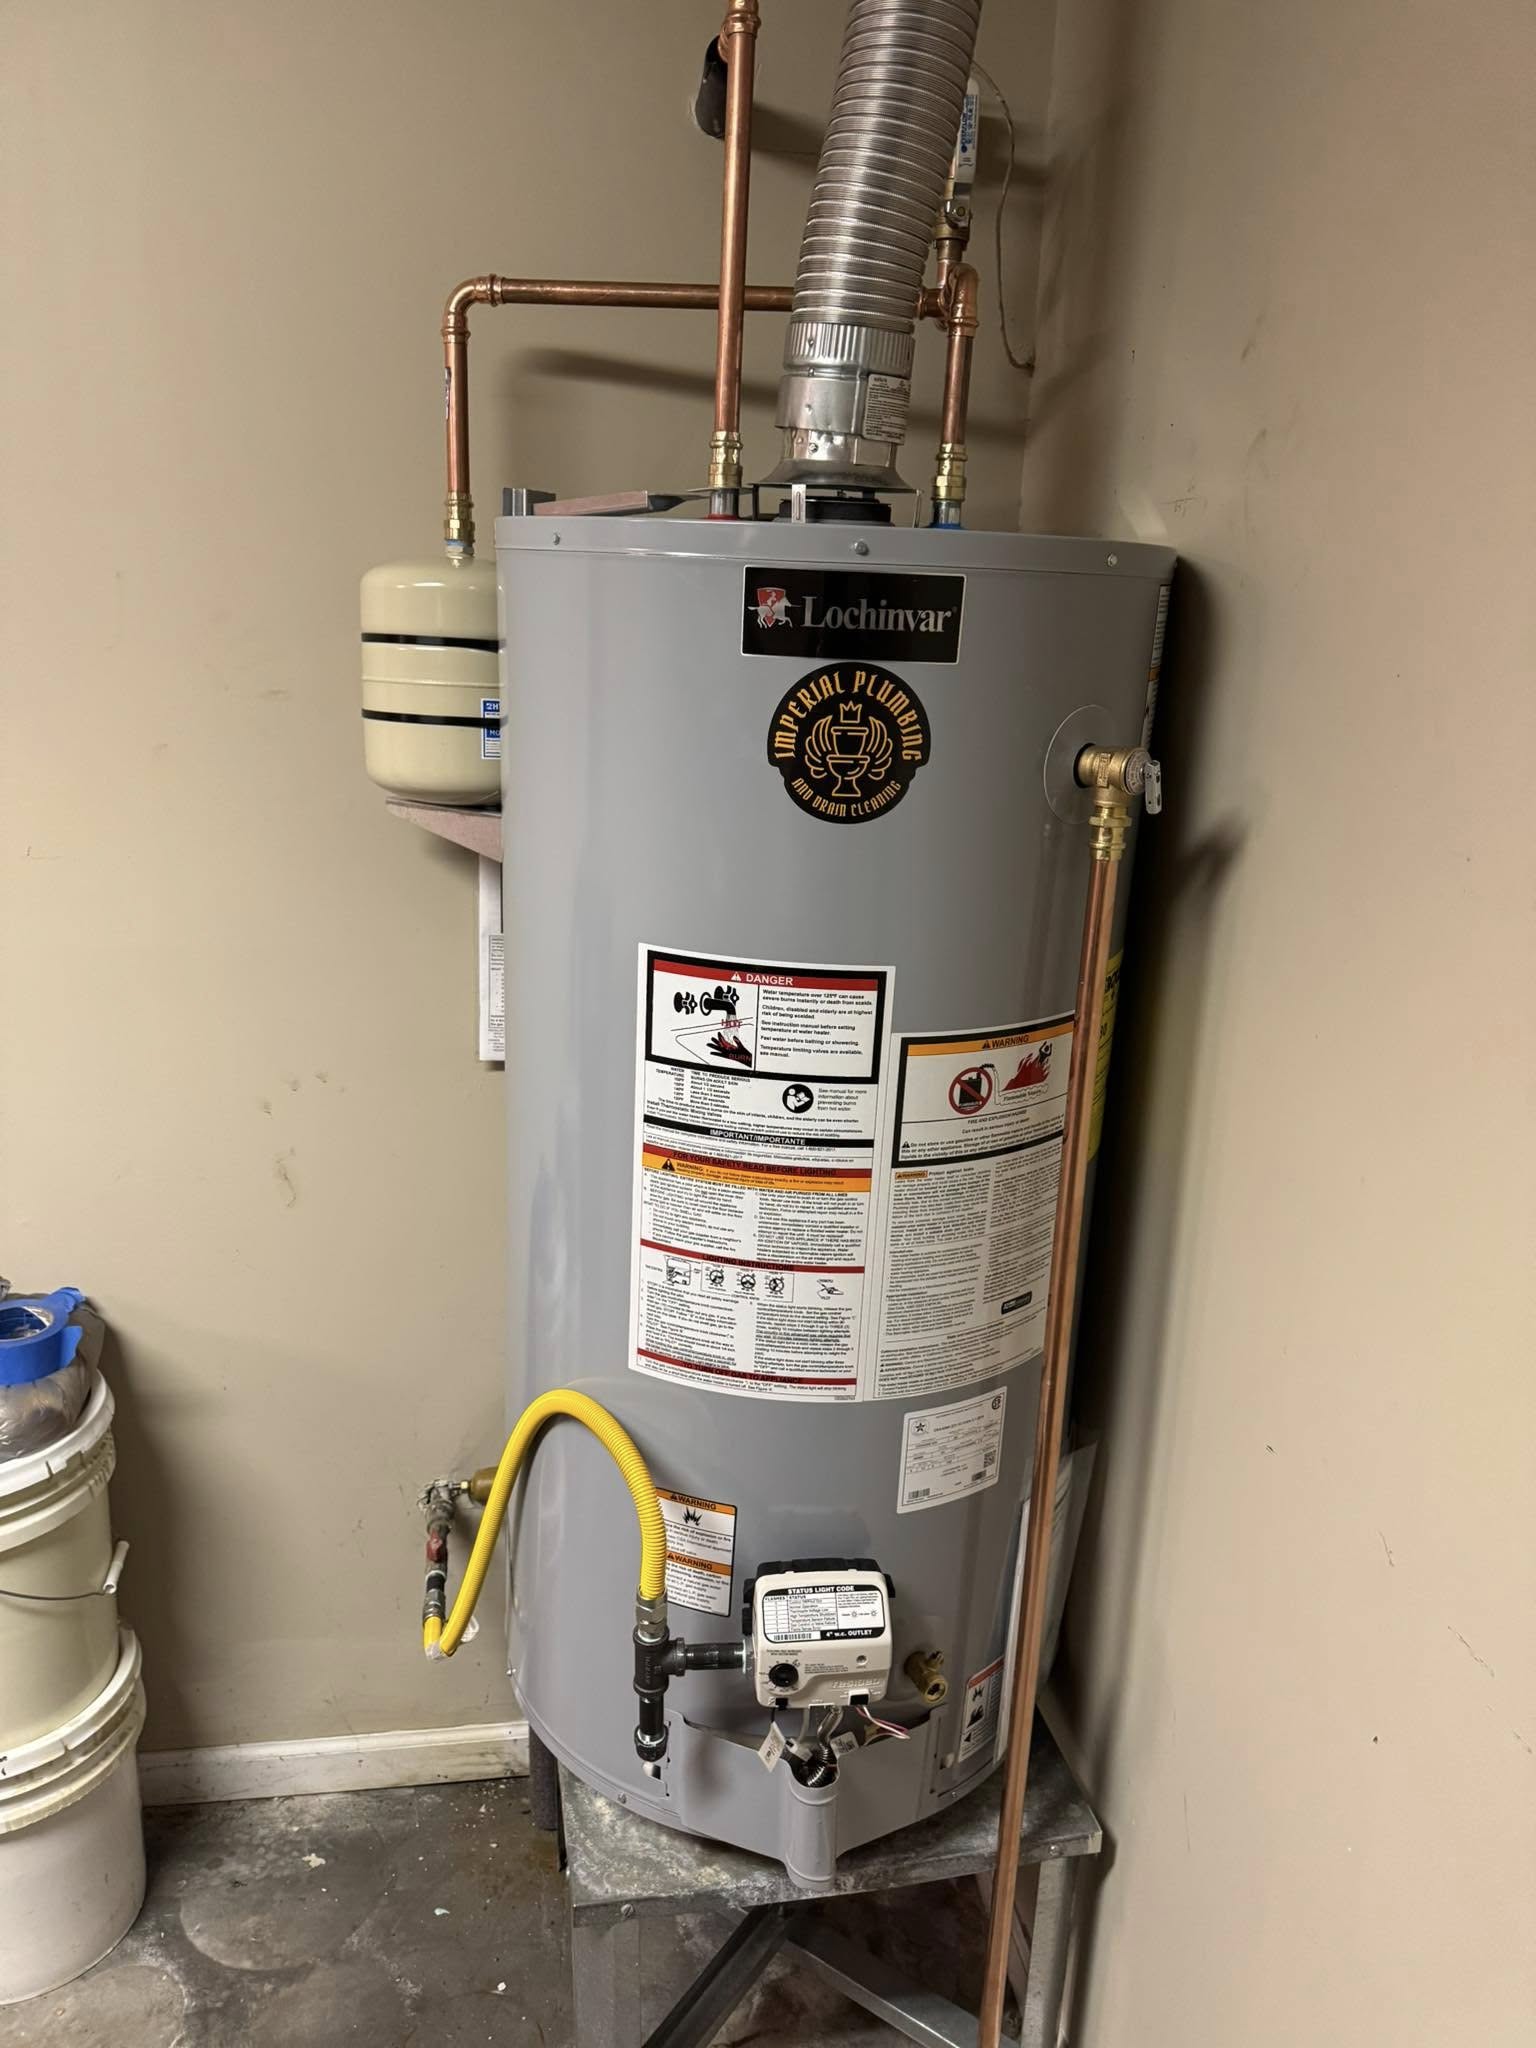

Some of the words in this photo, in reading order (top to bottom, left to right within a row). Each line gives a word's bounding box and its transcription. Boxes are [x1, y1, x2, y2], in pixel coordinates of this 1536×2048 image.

[802, 596, 952, 632] Lochinvar
[486, 702, 500, 710] 2H
[774, 671, 845, 759] IMPERIAL
[852, 670, 923, 761] PLUMBING
[812, 795, 846, 816] DRAIN
[851, 780, 901, 816] CLEANING
[746, 974, 793, 986] DANGER
[761, 1026, 791, 1034] temperature
[991, 1034, 1029, 1049] WARNING
[676, 1494, 717, 1510] WARNING
[673, 1554, 713, 1570] WARNING
